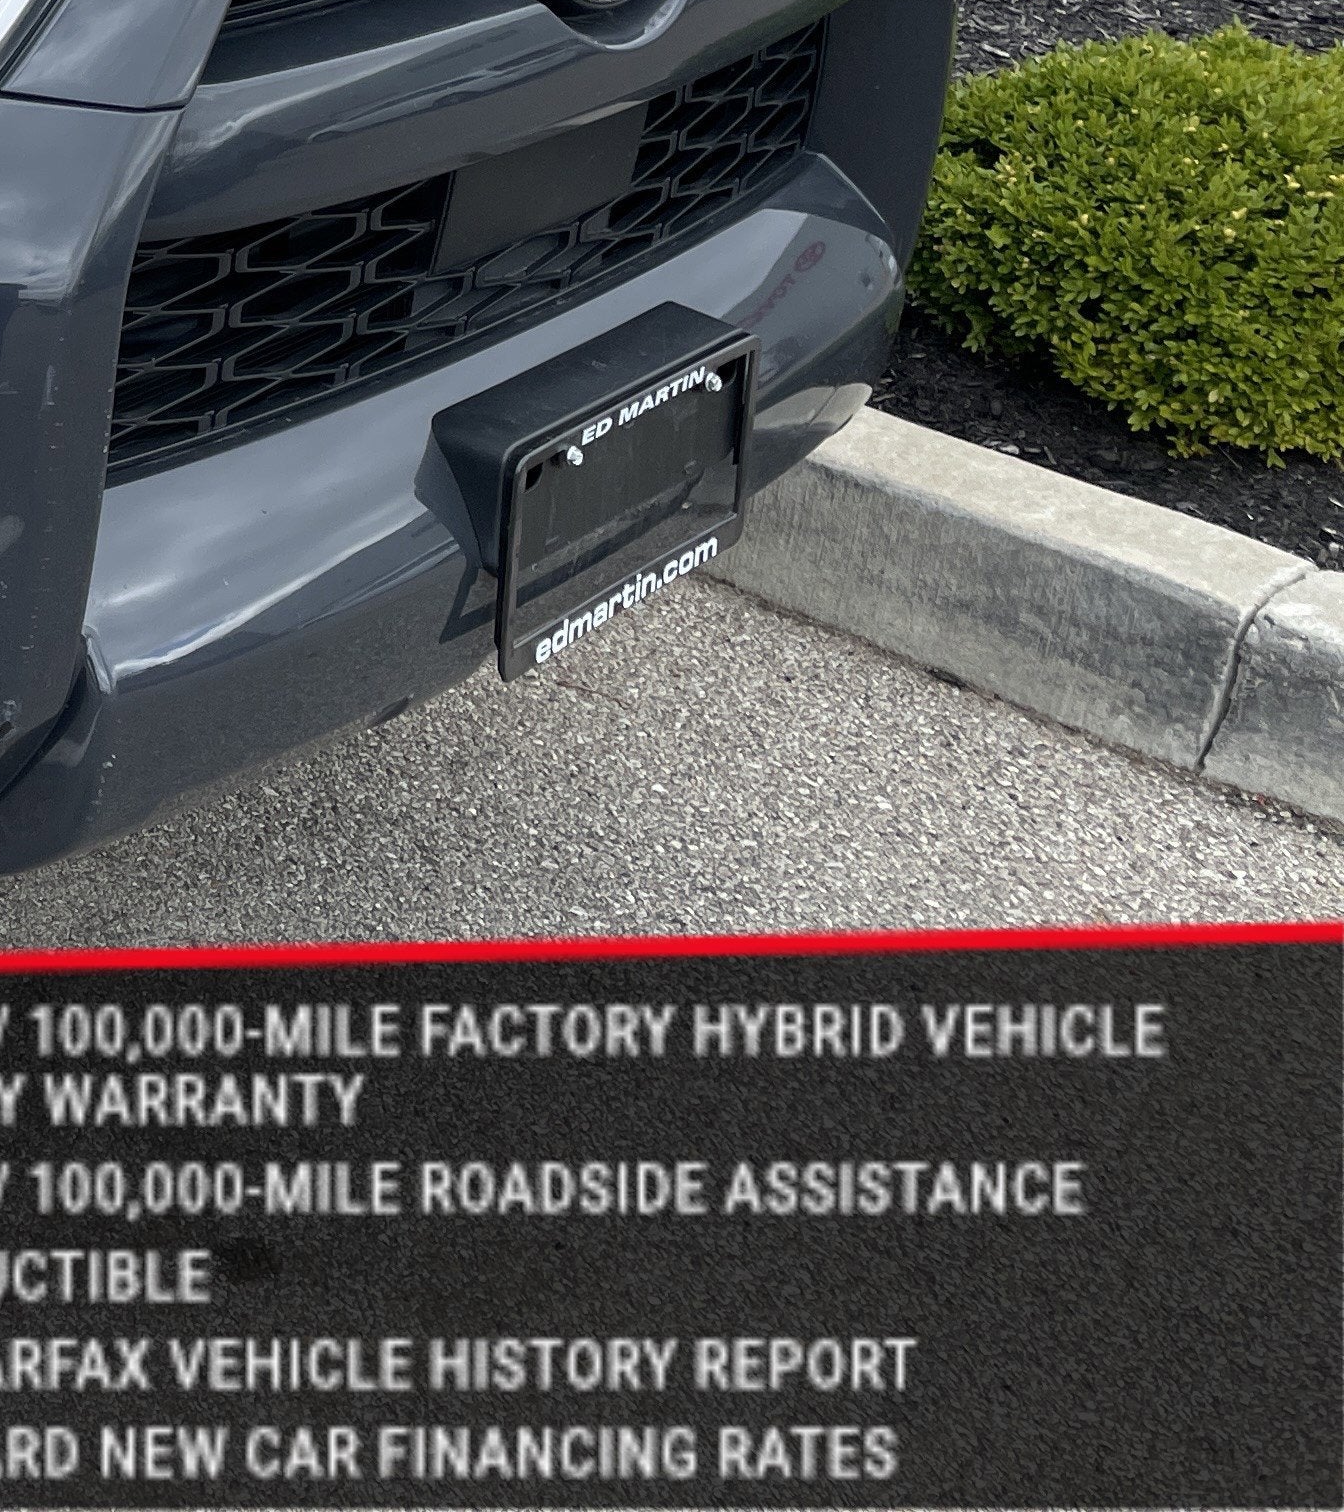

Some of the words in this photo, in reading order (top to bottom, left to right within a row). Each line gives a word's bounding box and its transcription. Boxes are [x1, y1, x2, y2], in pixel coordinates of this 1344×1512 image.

[581, 417, 613, 446] ED
[618, 366, 706, 426] MARTIN
[535, 536, 718, 664] edmartin.com
